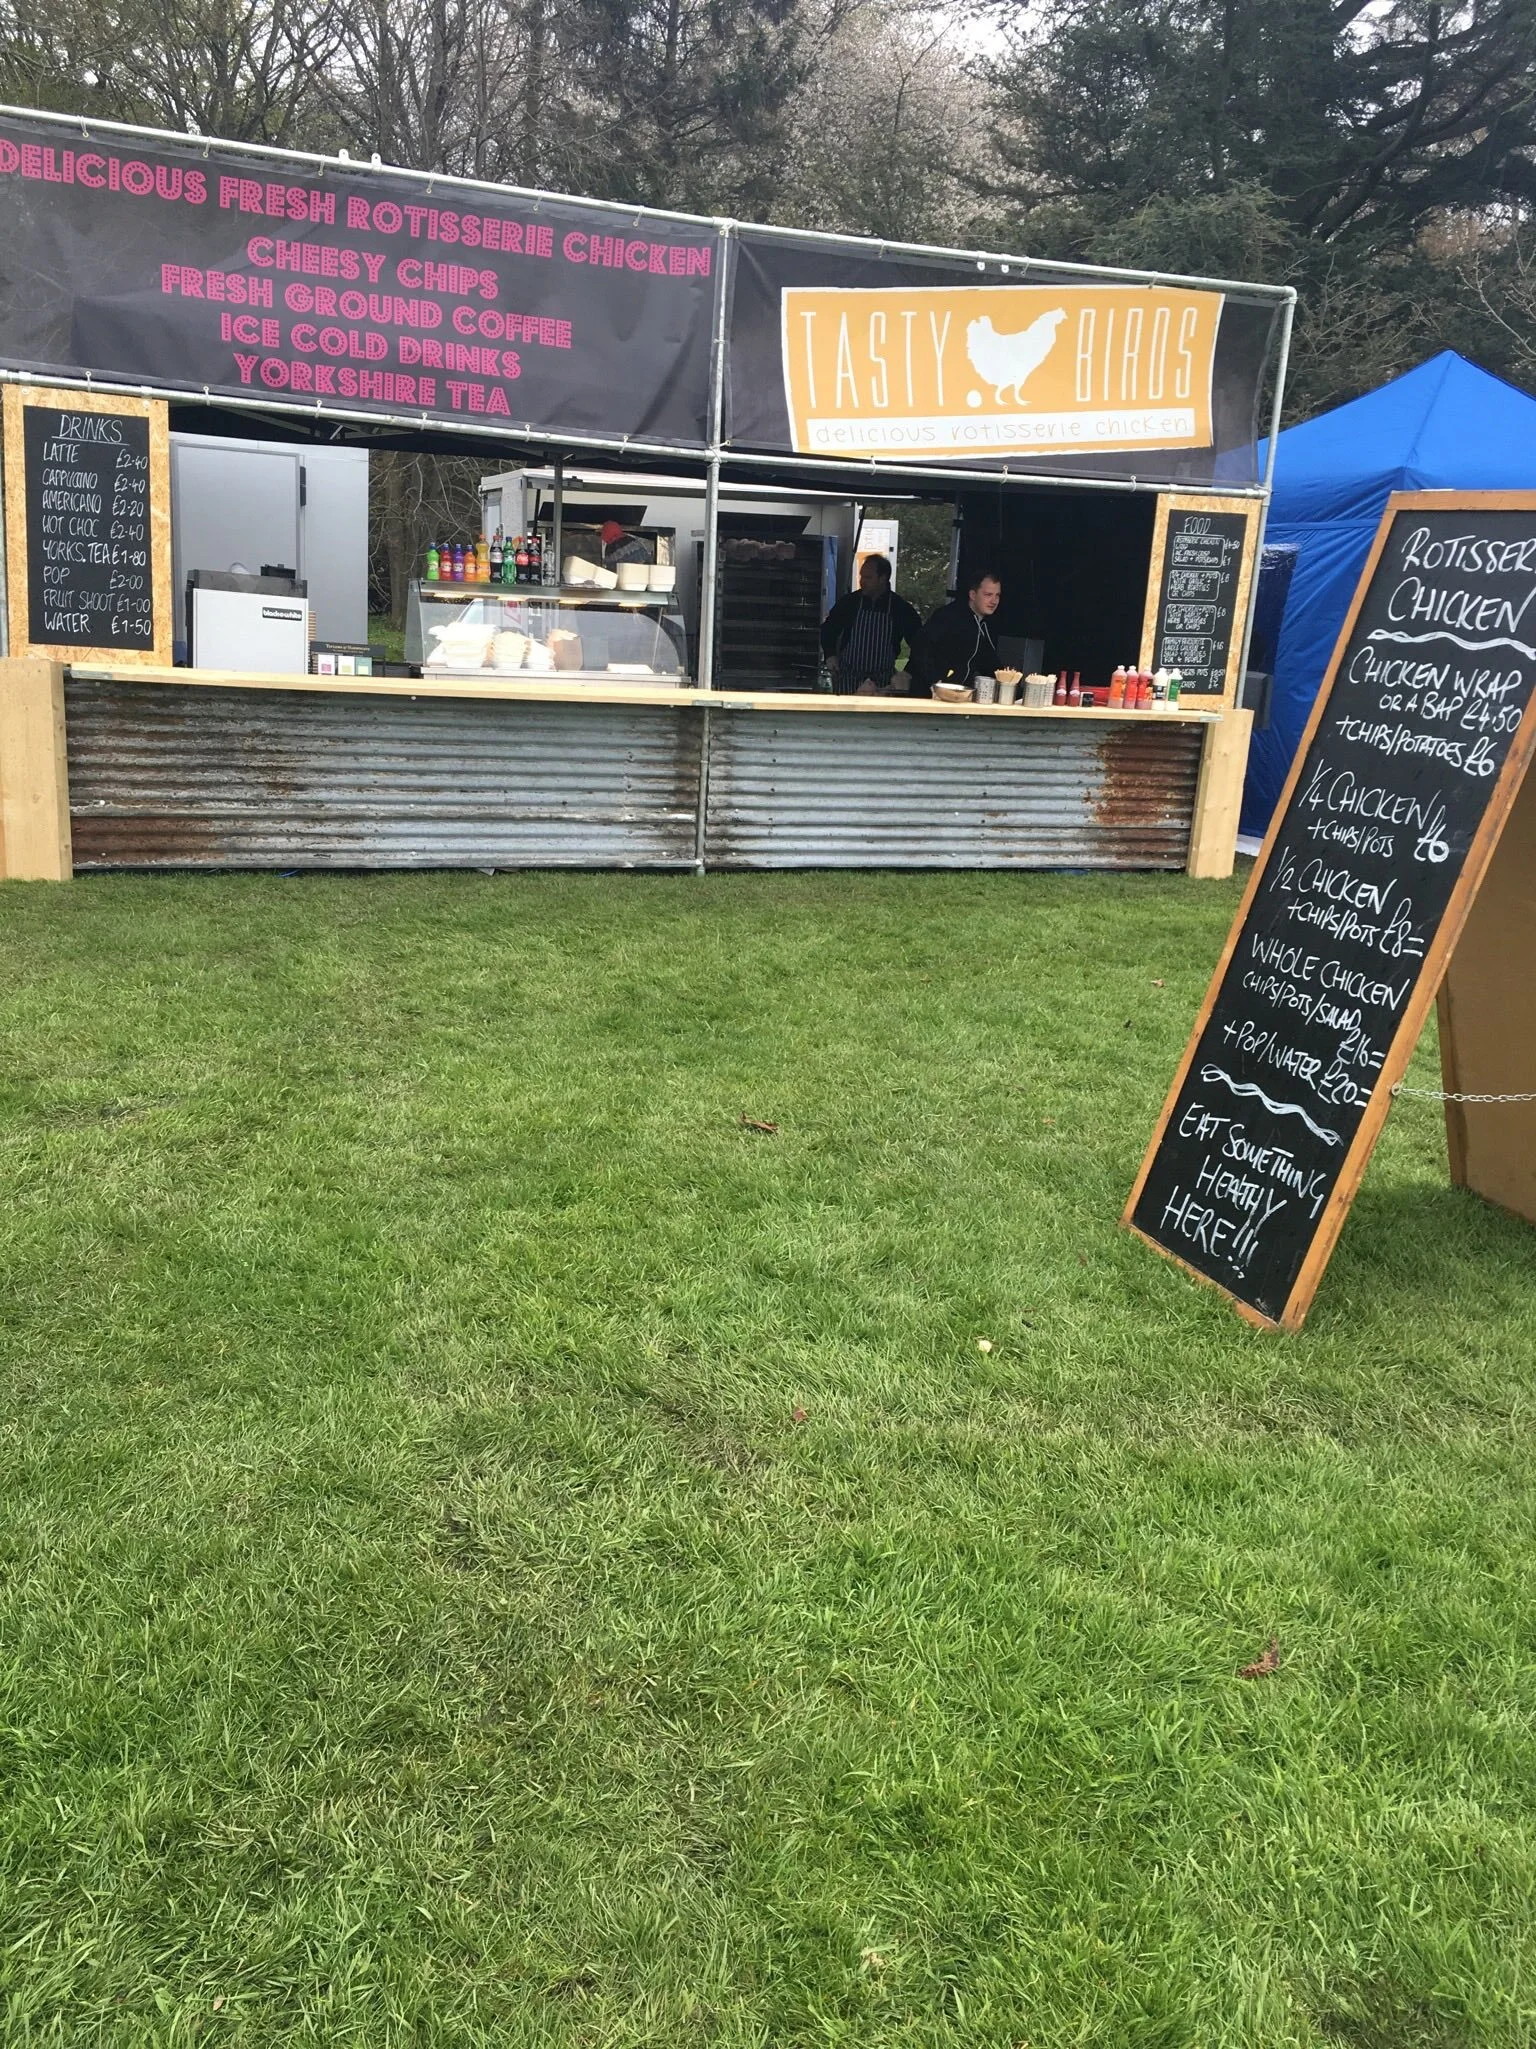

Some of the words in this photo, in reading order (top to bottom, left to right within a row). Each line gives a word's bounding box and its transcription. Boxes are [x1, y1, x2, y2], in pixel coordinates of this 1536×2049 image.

[0, 139, 208, 204] DELICIOUS
[219, 175, 335, 225] FRESH
[347, 196, 554, 257] ROTISSERIE
[562, 232, 711, 276] CHICKEN
[247, 235, 386, 284] CHEESY
[397, 258, 499, 300] CHIPS
[161, 263, 273, 308] FRESH
[285, 283, 442, 329] GROUND
[452, 305, 572, 348] COFFEE
[220, 313, 280, 348] ICE
[291, 323, 388, 361] COLD
[400, 336, 521, 379] DRINKS
[800, 310, 952, 409] TASTY
[1075, 307, 1198, 403] BIRDS
[233, 353, 436, 406] YORKSHIRE
[446, 380, 511, 416] TEA
[43, 441, 80, 463] LATTE
[60, 414, 123, 443] DRINKS
[815, 423, 936, 445] delicious
[951, 418, 1081, 441] rotisserie
[1095, 413, 1189, 435] chicken
[42, 490, 101, 513] AMERICANO
[42, 515, 64, 534] HOT
[69, 517, 99, 537] CHOC
[1184, 516, 1211, 534] FOOD
[43, 565, 70, 584] POP
[88, 542, 110, 564] TEA
[1401, 527, 1536, 573] ROTISSER
[43, 588, 75, 608] FRUIT
[79, 590, 115, 611] SHOOT
[44, 611, 90, 633] WATER
[1388, 576, 1536, 633] CHICKEN
[1349, 645, 1450, 689] CHICKEN
[1454, 668, 1522, 703] WRAP
[1379, 694, 1403, 711] OR
[1405, 693, 1418, 712] A
[1421, 691, 1463, 721] BAP
[1463, 736, 1498, 776] £6
[1327, 771, 1442, 829] CHICKEN
[1414, 805, 1449, 863] £6
[1298, 858, 1397, 914] CHICKEN
[1252, 934, 1320, 980] WHOLE
[1320, 961, 1410, 1010] CHICKEN
[1179, 1102, 1230, 1141] EAT
[1222, 1124, 1326, 1219] SOMETHING
